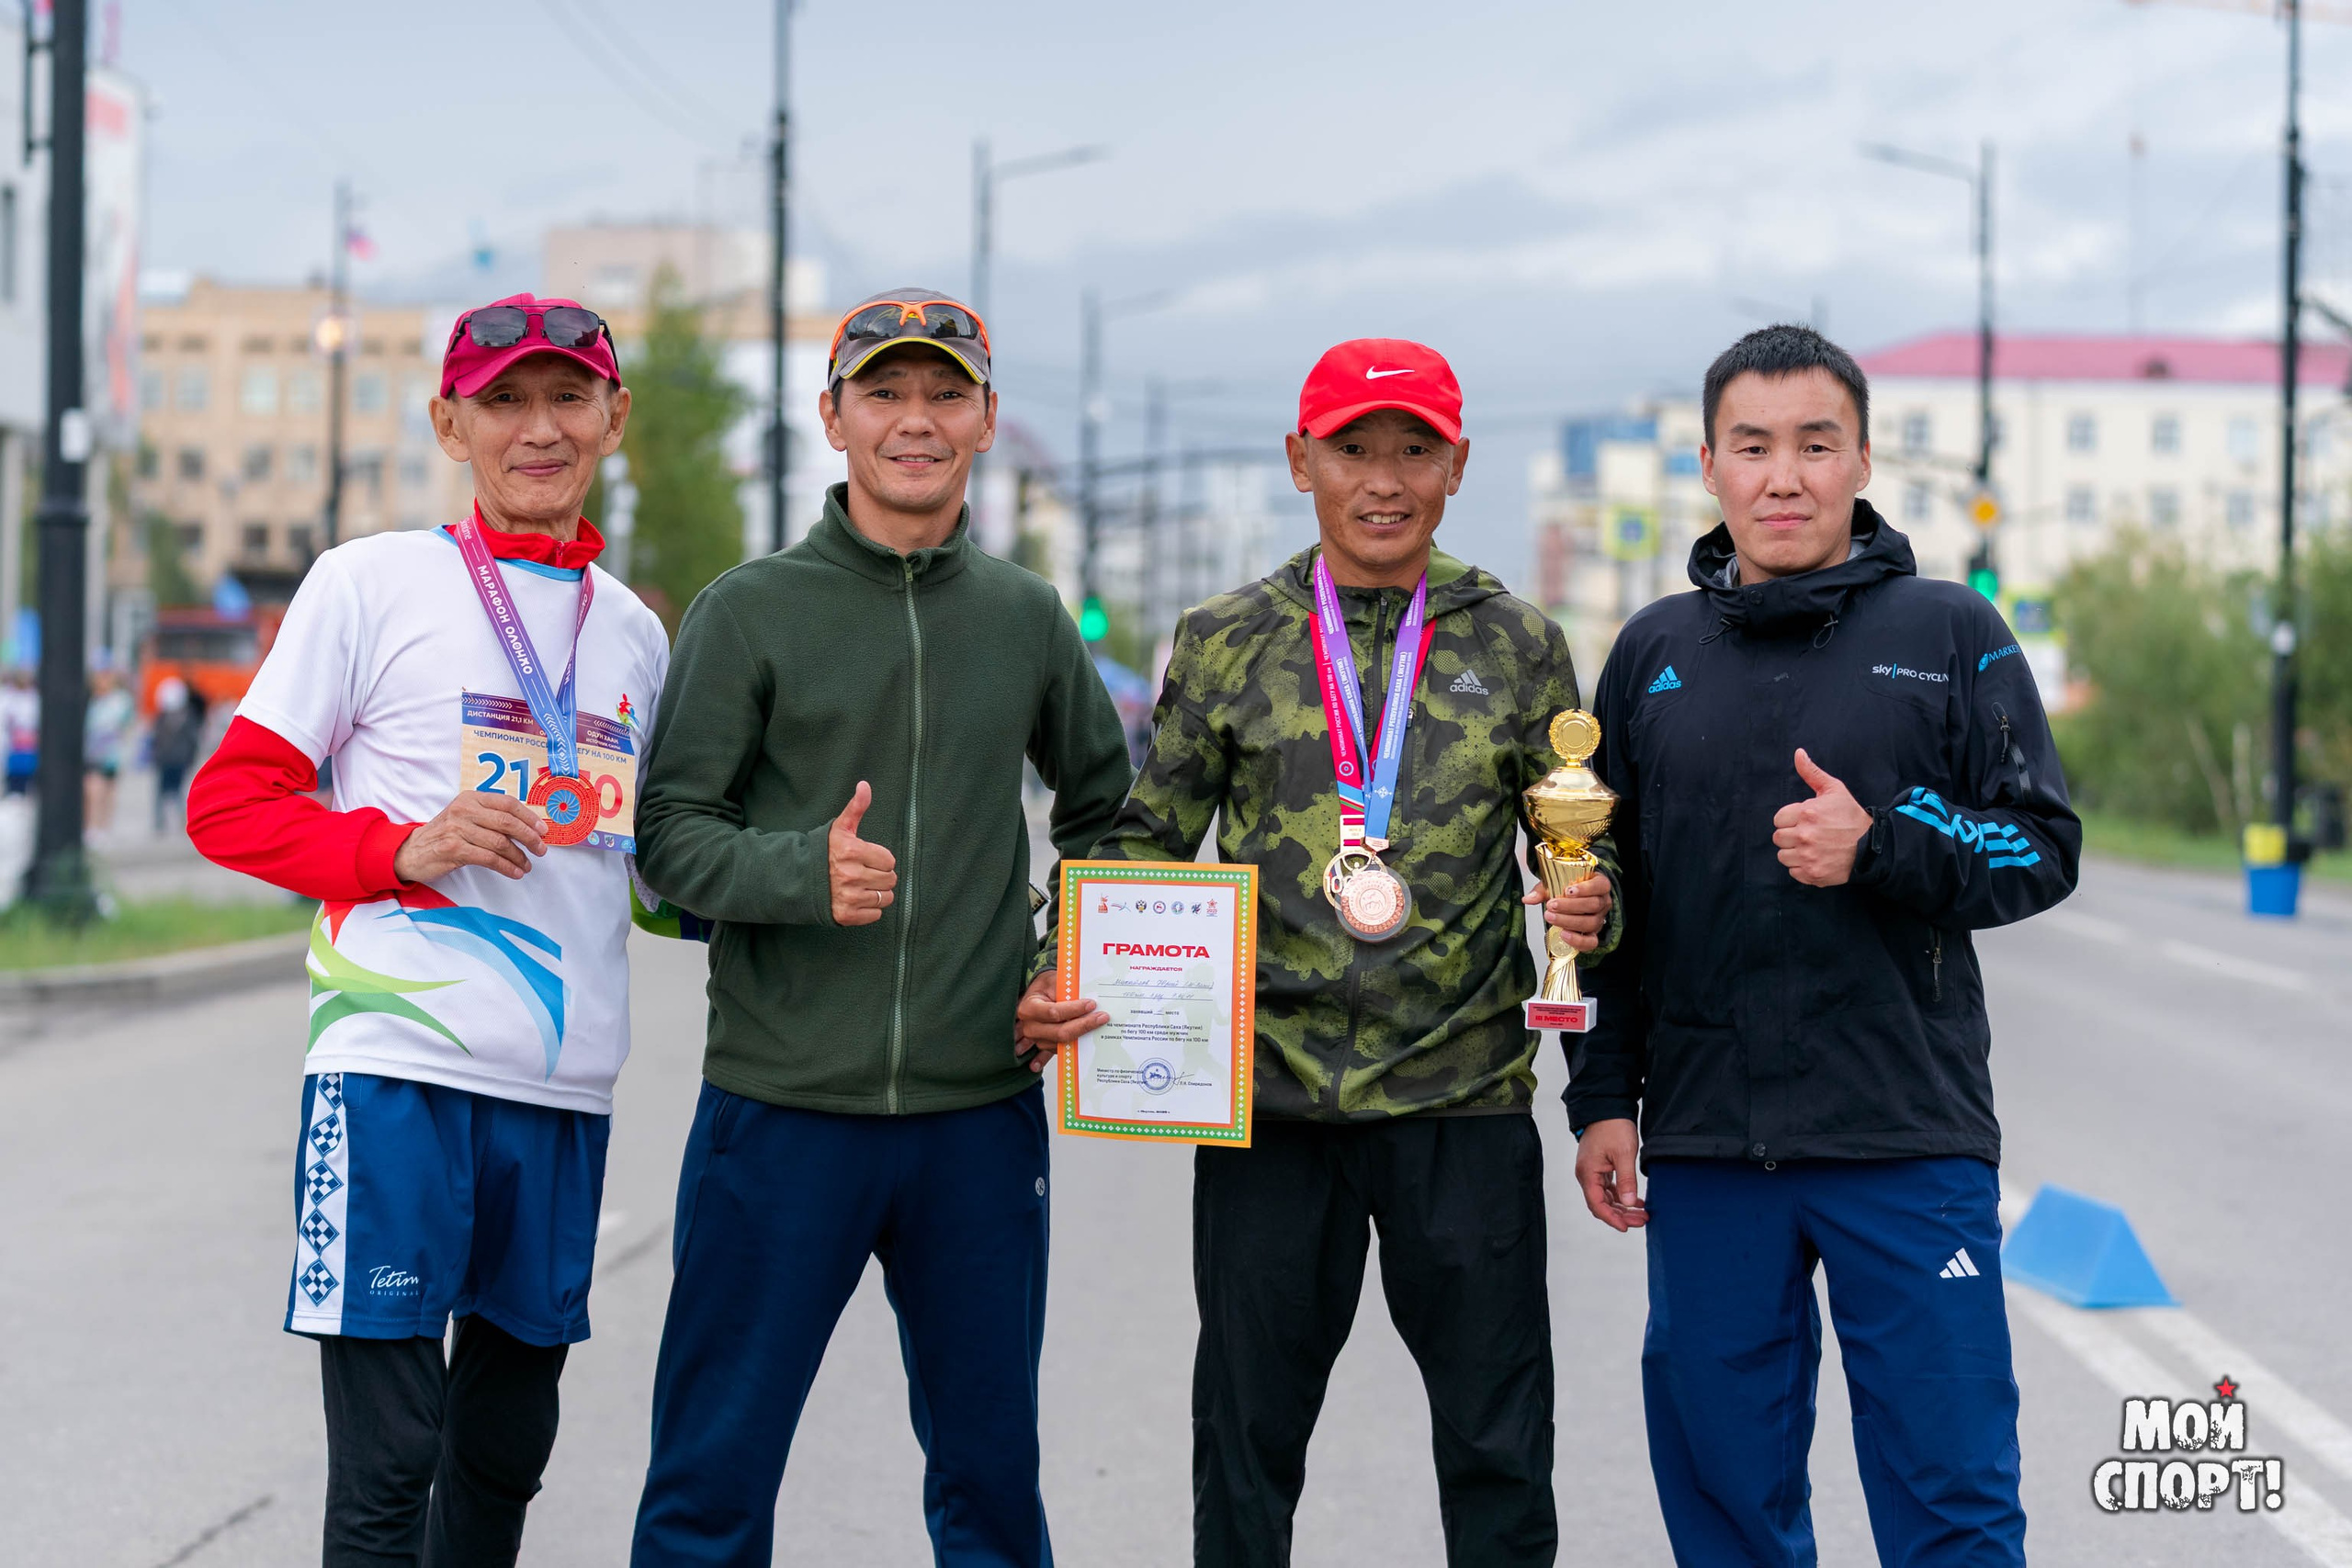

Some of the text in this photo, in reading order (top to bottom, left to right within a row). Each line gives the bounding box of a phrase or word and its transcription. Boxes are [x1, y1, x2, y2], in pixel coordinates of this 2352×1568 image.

[477, 565, 510, 624] МАРАФОН
[1871, 664, 1893, 676] sky
[1896, 669, 1917, 678] PRO
[1450, 682, 1488, 695] adidas
[1648, 680, 1681, 694] adidas
[467, 710, 510, 721] ДИСТАНЦИЯ
[473, 730, 524, 744] ЧЕМПИОНАТ
[526, 738, 548, 749] РОСС
[592, 749, 602, 759] НА
[603, 752, 615, 761] 100
[616, 755, 627, 764] КМ
[1102, 942, 1210, 958] ГРАМОТА
